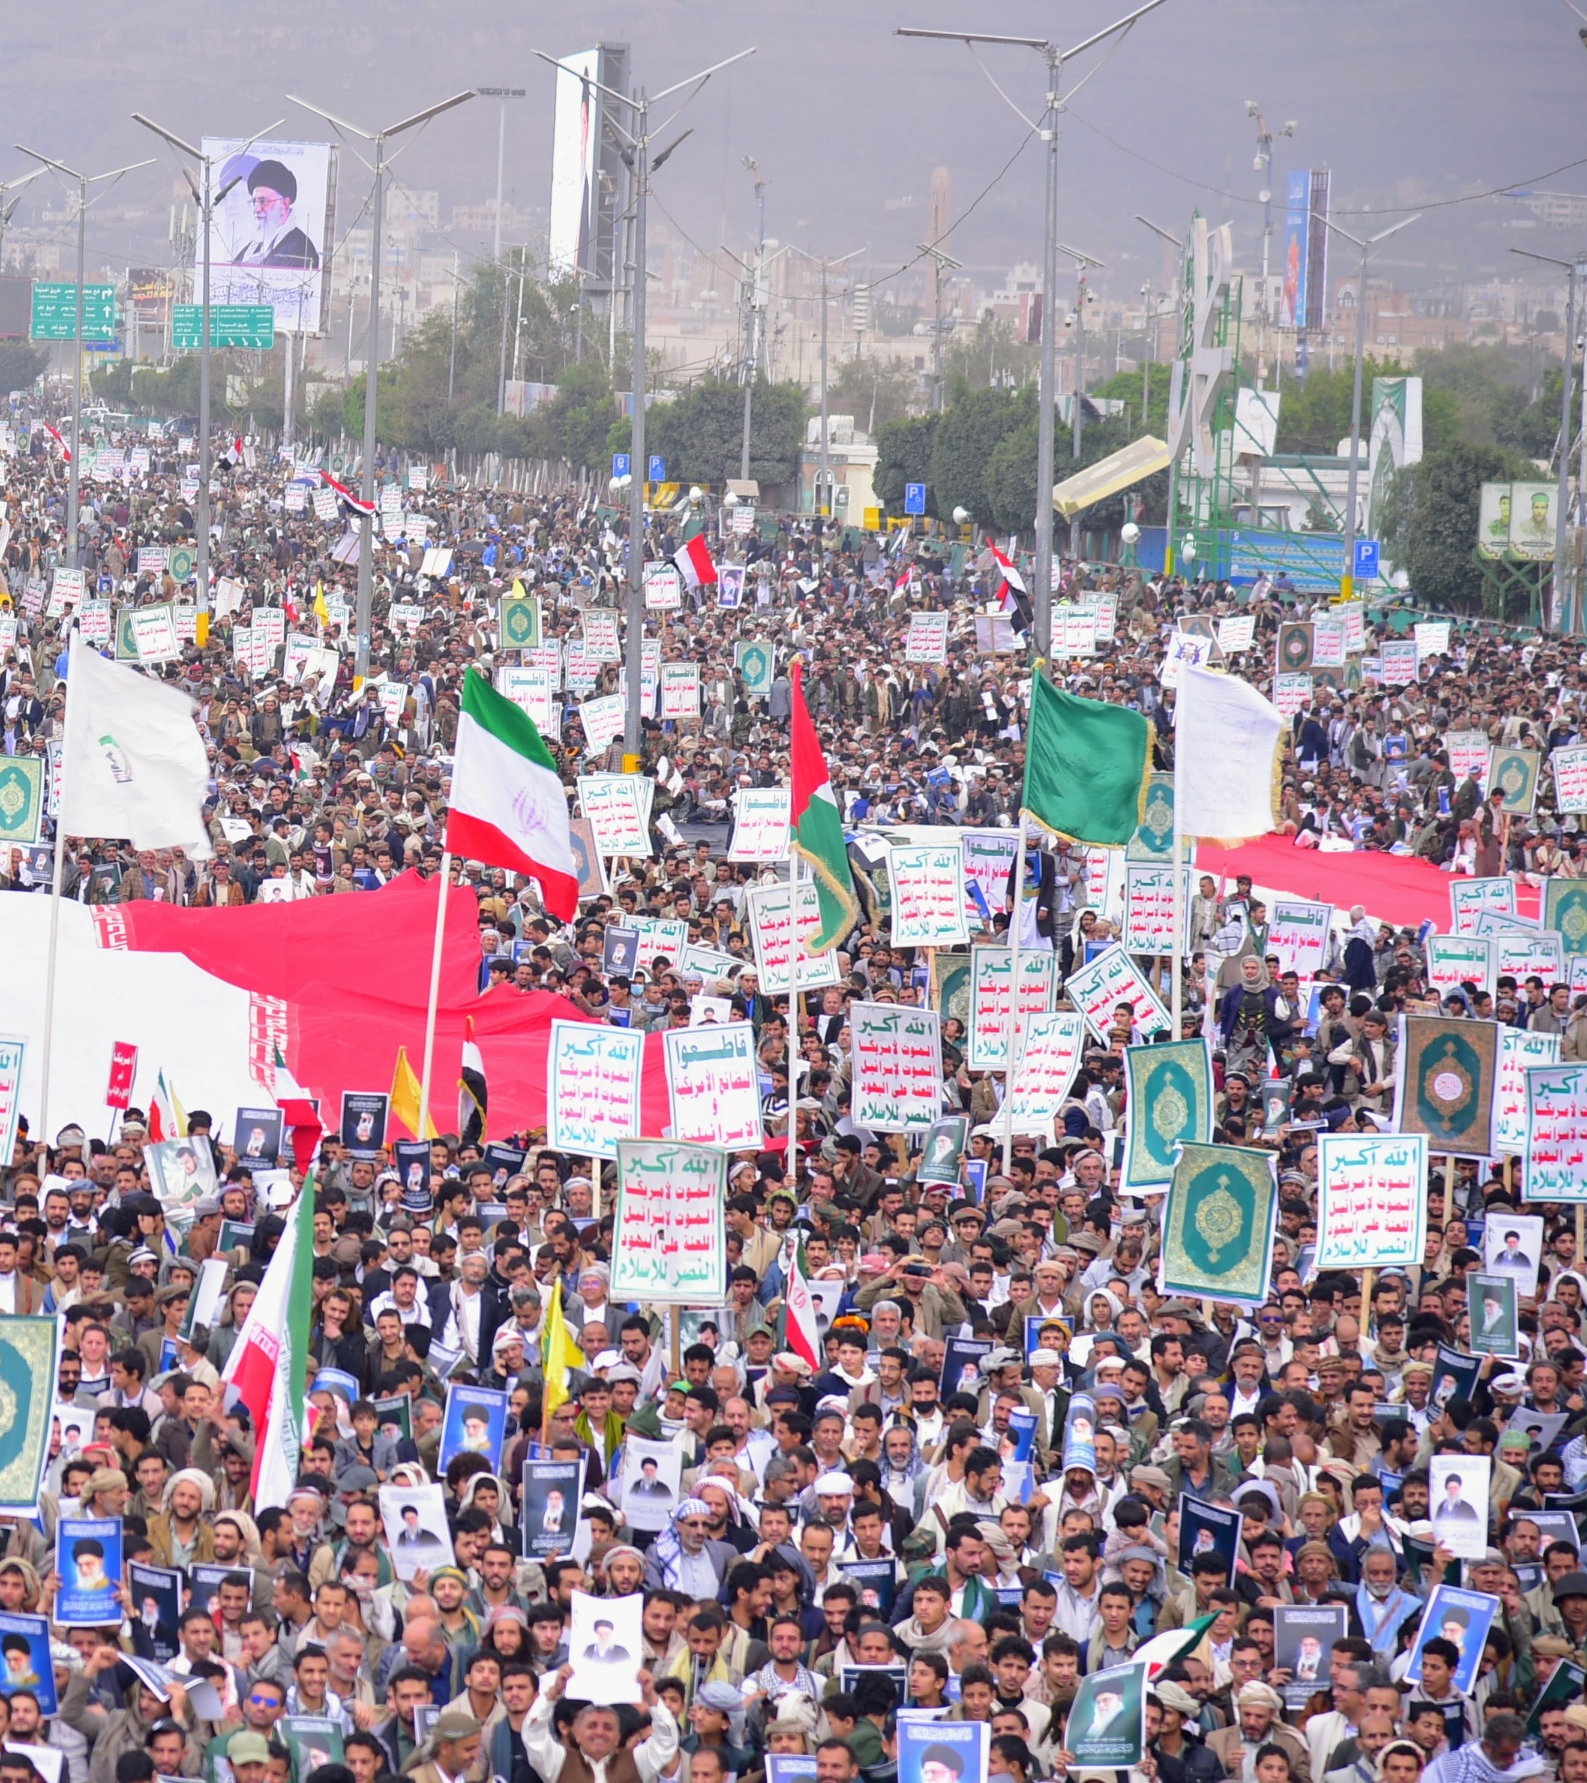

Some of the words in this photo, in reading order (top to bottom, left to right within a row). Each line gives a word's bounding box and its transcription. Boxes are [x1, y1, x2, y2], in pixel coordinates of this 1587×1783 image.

[1360, 545, 1373, 561] P
[858, 1013, 902, 1036] أكبر
[904, 1021, 933, 1036] الله
[560, 1034, 605, 1061] أكبر
[607, 1040, 636, 1061] الله
[858, 1039, 899, 1056] لأمريكا
[901, 1044, 935, 1059] الموت
[558, 1062, 600, 1080] لأمريكا
[602, 1071, 634, 1084] الموت
[860, 1059, 900, 1079] لإسرائيل
[902, 1065, 937, 1078] الموت
[558, 1084, 599, 1101] لإسرائيل
[861, 1081, 889, 1097] اليهود
[891, 1083, 908, 1099] على
[911, 1083, 936, 1098] اللعنة
[601, 1092, 633, 1105] الموت
[558, 1107, 586, 1122] اليهود
[589, 1108, 605, 1124] على
[608, 1113, 632, 1126] اللعنة
[859, 1101, 900, 1122] للإسلام
[903, 1104, 937, 1125] النصر
[555, 1123, 597, 1144] للإسلام
[626, 1149, 680, 1176] أكبر
[1329, 1142, 1382, 1172] أكبر
[1383, 1146, 1417, 1167] الله
[681, 1157, 718, 1178] الله
[624, 1178, 672, 1201] لأمريكا
[675, 1184, 716, 1202] الموت
[1329, 1175, 1373, 1193] لأمريكا
[1377, 1177, 1415, 1192] الموت
[1328, 1197, 1373, 1218] لإسرائيل
[1376, 1199, 1414, 1214] الموت
[623, 1205, 671, 1228] لإسرائيل
[674, 1209, 715, 1228] الموت
[1327, 1221, 1358, 1237] اليهود
[1361, 1218, 1380, 1234] على
[1384, 1220, 1413, 1233] اللعنة
[621, 1232, 658, 1252] اليهود
[659, 1231, 679, 1255] على
[683, 1235, 715, 1252] اللعنة
[1324, 1239, 1369, 1261] للإسلام
[1372, 1240, 1412, 1260] النصر
[618, 1256, 669, 1287] للإسلام
[671, 1261, 715, 1289] النصر
